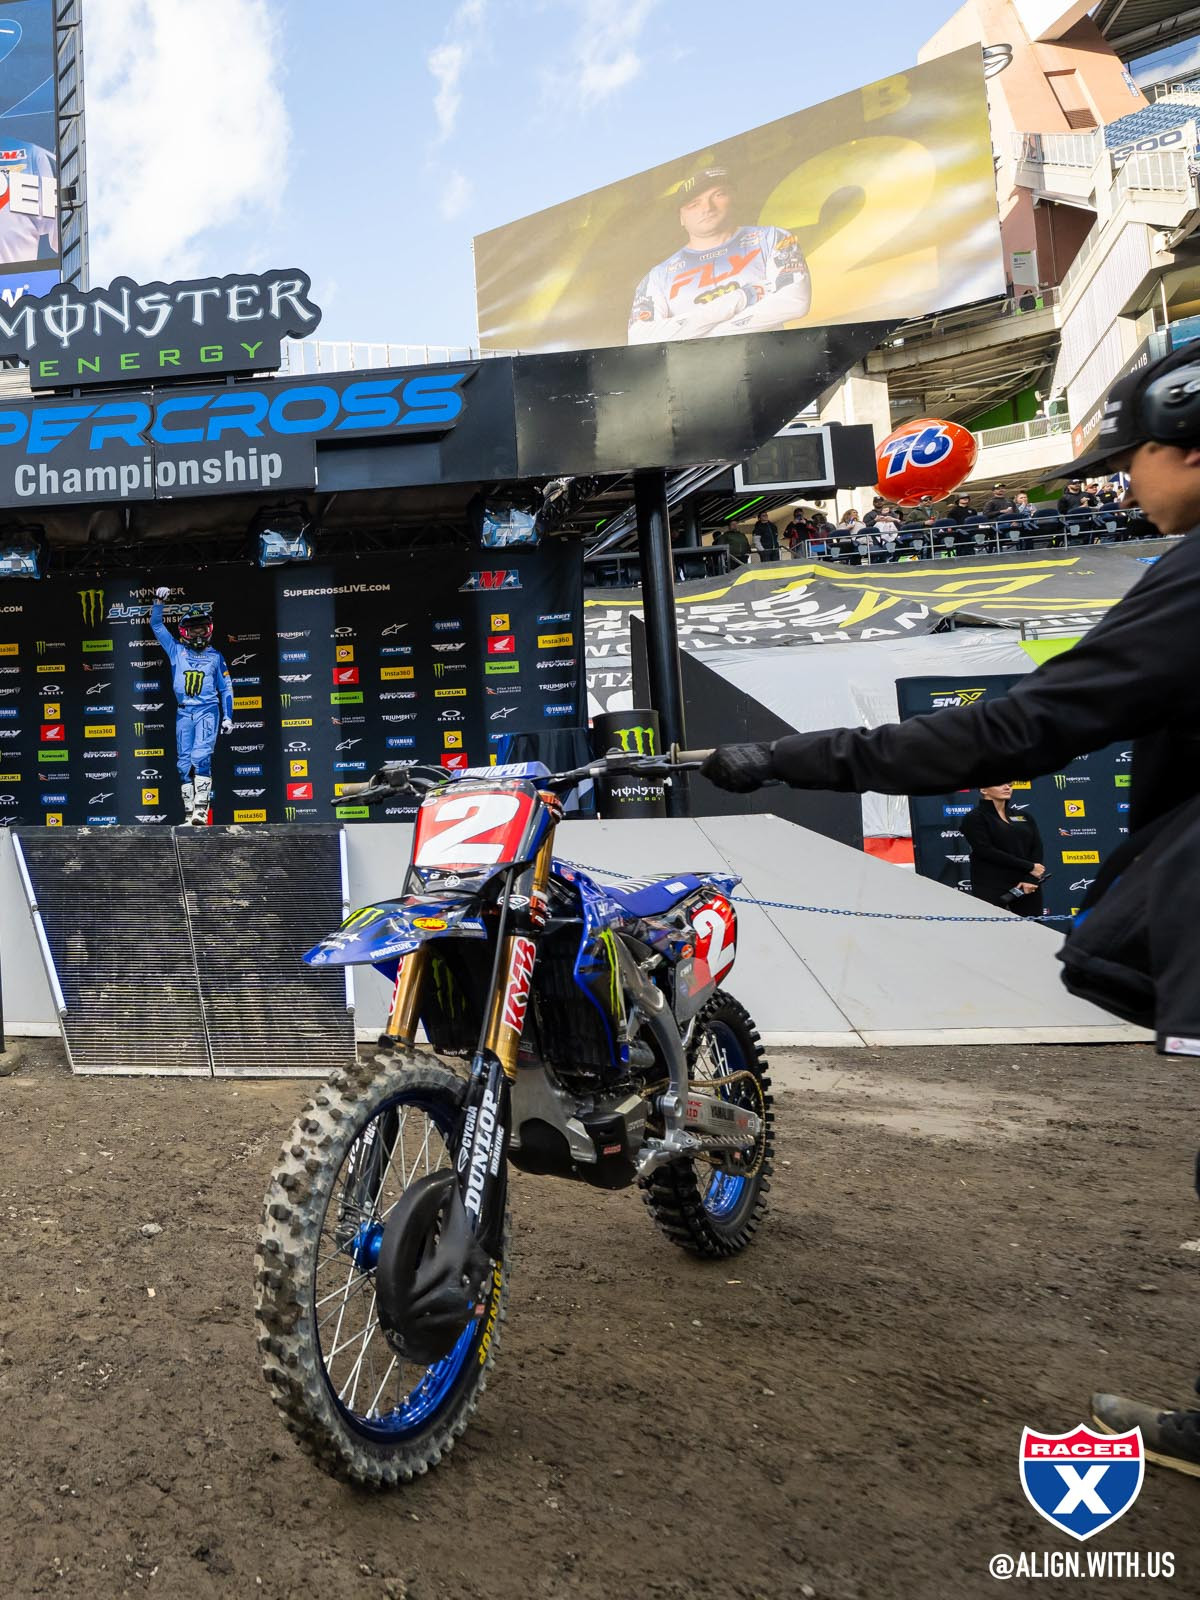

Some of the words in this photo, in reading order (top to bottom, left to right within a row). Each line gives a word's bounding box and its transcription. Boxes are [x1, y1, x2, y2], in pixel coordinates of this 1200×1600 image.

[1113, 130, 1183, 161] 300
[670, 248, 761, 300] FLY
[38, 341, 264, 377] ENERGY
[15, 447, 283, 497] Championship
[885, 426, 953, 479] 76
[129, 587, 186, 599] MONER
[458, 570, 522, 592] AMA
[107, 602, 215, 618] SUPECROSS
[542, 636, 570, 645] Insta360
[539, 681, 569, 691] TRIUMPH
[931, 691, 983, 708] SMX
[611, 785, 665, 797] MONSTER
[415, 794, 520, 866] 2
[370, 941, 415, 959] PROGRESSIVE
[693, 909, 736, 978] 2
[503, 936, 537, 1035] KYB
[461, 1105, 478, 1147] CYCRA
[465, 1089, 499, 1215] DUNLOP
[490, 1125, 505, 1177] BRAKING
[478, 1268, 502, 1365] DUNLOP
